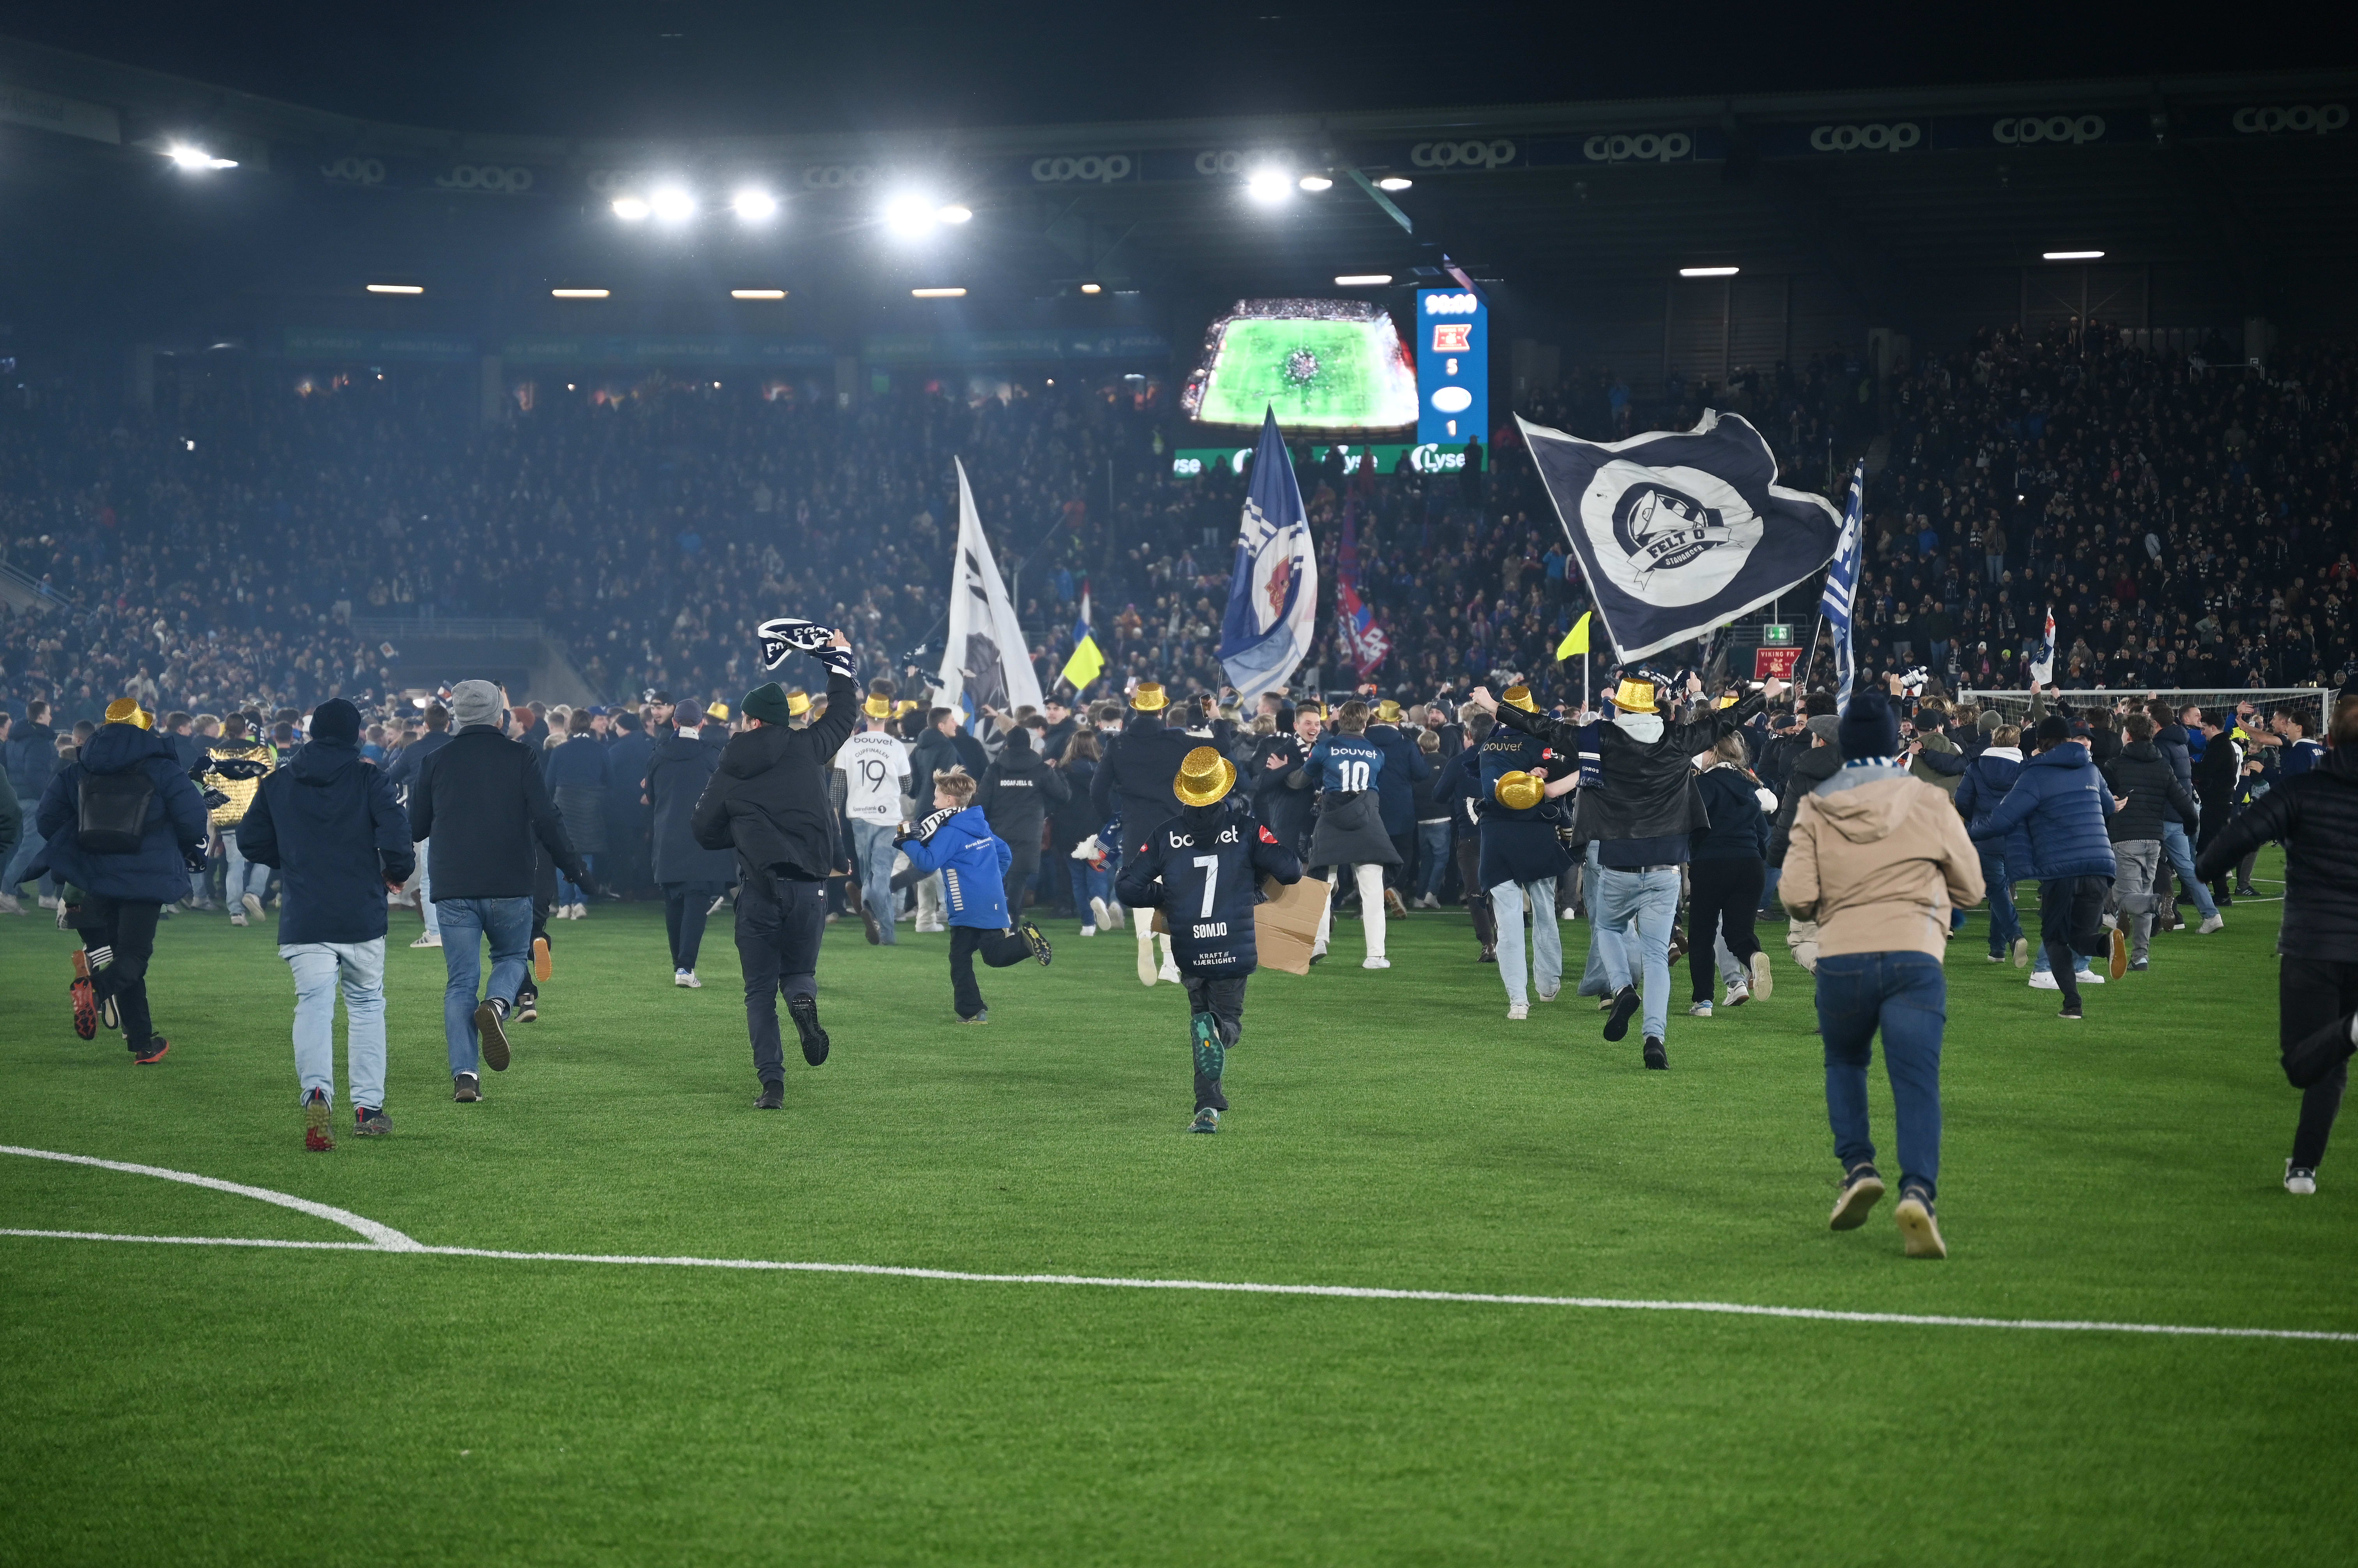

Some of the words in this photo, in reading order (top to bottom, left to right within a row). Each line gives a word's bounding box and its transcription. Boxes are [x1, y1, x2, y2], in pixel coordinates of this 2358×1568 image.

[1993, 115, 2106, 144] coop
[2233, 104, 2349, 134] coop
[1583, 133, 1691, 162] coop
[1810, 122, 1921, 152] coop
[1410, 139, 1516, 168] coop
[1030, 154, 1131, 183] coop
[1446, 358, 1458, 375] 5
[1447, 420, 1456, 436] 1
[1425, 451, 1466, 473] Lyse
[1646, 531, 1686, 559] FELT
[1665, 545, 1704, 566] STAVANGER
[854, 737, 893, 746] bouvet
[855, 748, 889, 759] CUPFINALEN
[1331, 746, 1377, 759] bouvet
[1483, 741, 1522, 751] bouvet
[857, 759, 886, 793] 19
[1338, 760, 1370, 792] 10
[1170, 825, 1239, 849] boet
[1193, 854, 1219, 918] 7
[1193, 922, 1227, 939] SØMJO
[1193, 956, 1236, 966] KJÆRLIGHET
